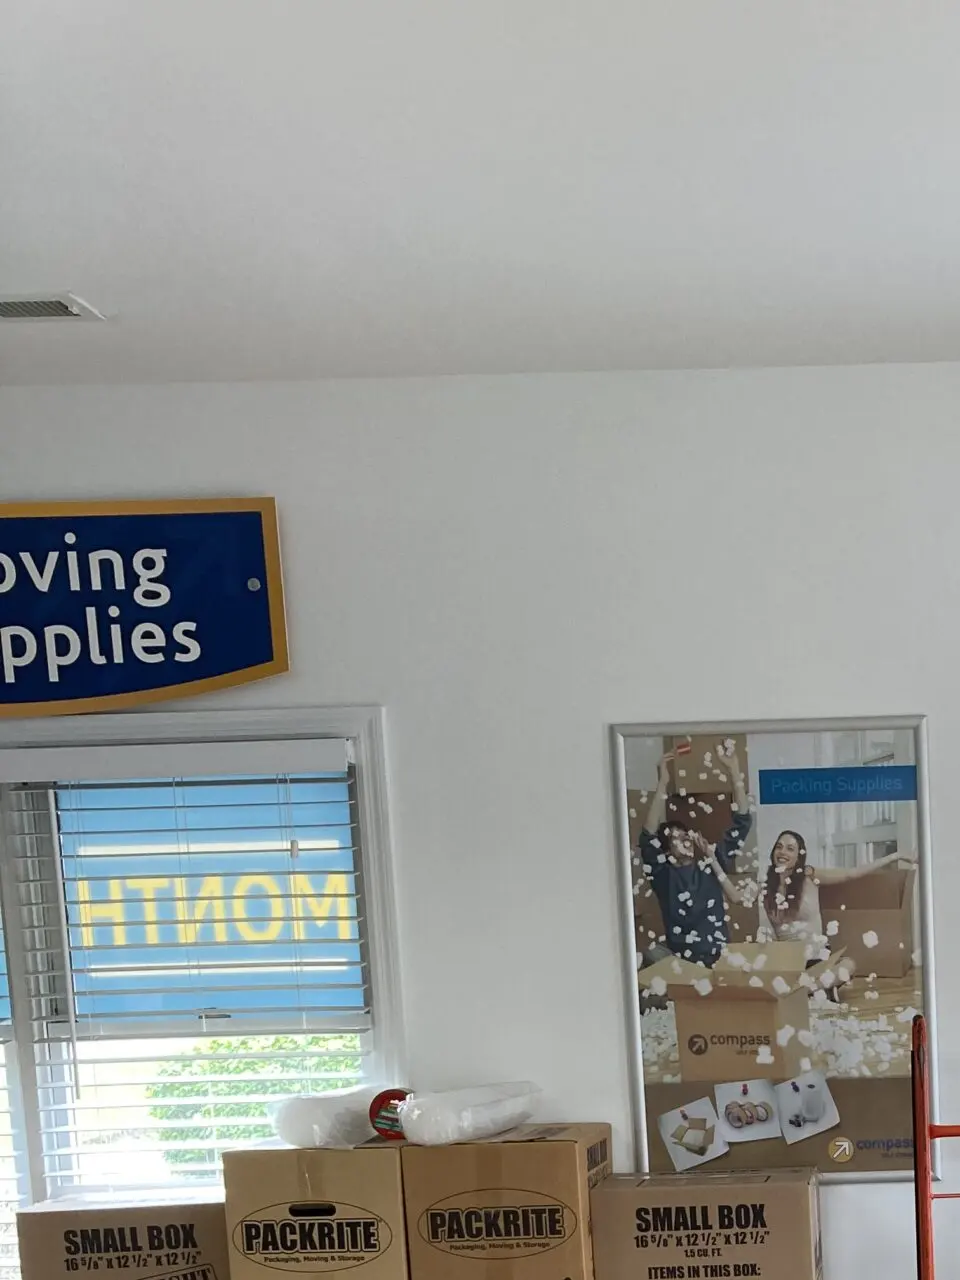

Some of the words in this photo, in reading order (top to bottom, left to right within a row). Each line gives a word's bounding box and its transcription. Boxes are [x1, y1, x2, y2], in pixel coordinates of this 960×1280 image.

[0, 605, 201, 683] pplies
[771, 777, 832, 796] Packing
[836, 775, 903, 793] Supplies
[710, 1034, 771, 1047] compass
[428, 1206, 565, 1241] PACKRITE
[635, 1205, 713, 1233] SMALL
[718, 1203, 768, 1229] BOX
[63, 1226, 142, 1255] SMALL
[146, 1223, 198, 1250] BOX
[243, 1220, 380, 1253] PACKRITE
[488, 1242, 515, 1250] Moving
[633, 1235, 649, 1248] 16
[684, 1233, 699, 1247] 12
[732, 1231, 746, 1245] 12
[697, 1248, 711, 1258] CU.
[711, 1247, 723, 1257] FT.
[648, 1264, 685, 1280] ITEMS
[687, 1265, 700, 1279] IN
[702, 1264, 731, 1278] THIS
[733, 1263, 761, 1277] BOX:
